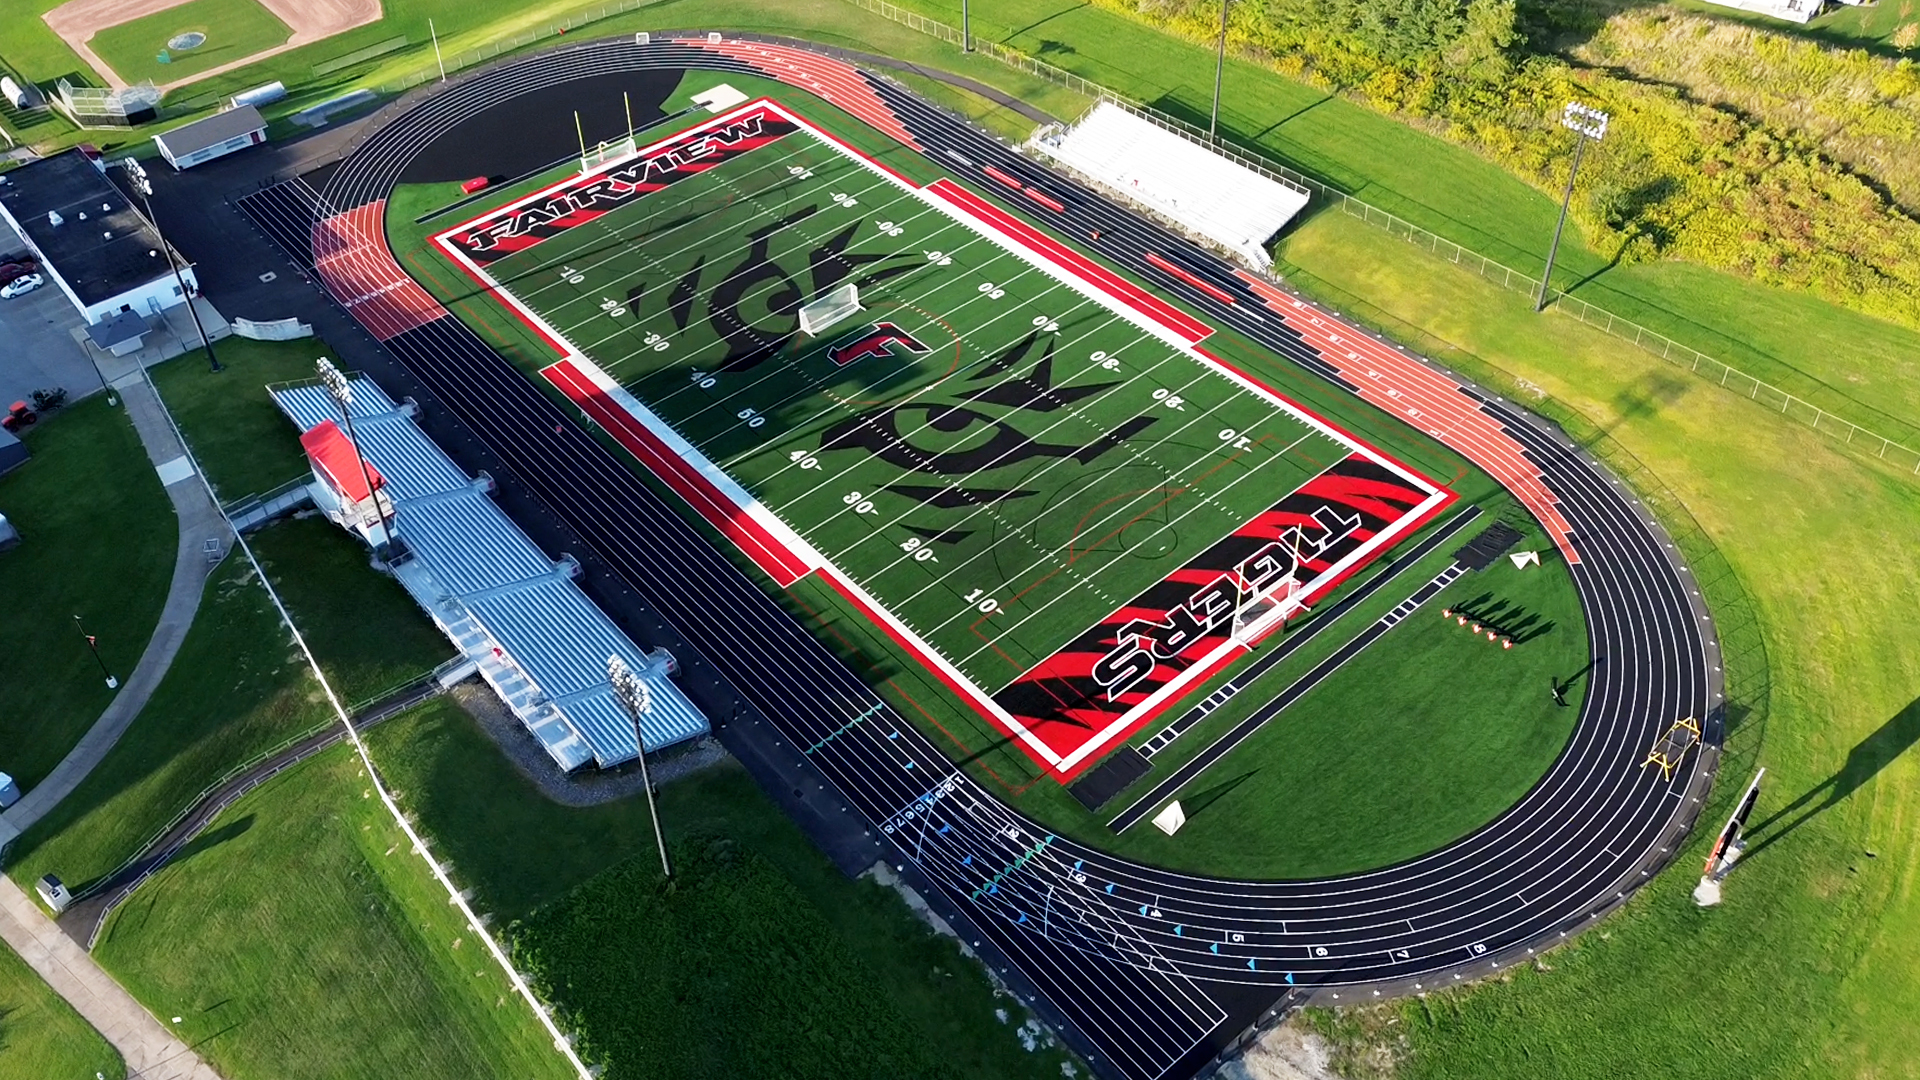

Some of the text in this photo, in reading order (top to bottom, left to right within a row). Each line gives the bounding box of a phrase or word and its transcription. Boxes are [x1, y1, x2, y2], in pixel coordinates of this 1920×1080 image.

[466, 112, 765, 252] FAIRVIEW
[790, 166, 814, 181] 10
[833, 193, 859, 208] 20
[878, 221, 904, 237] 30
[926, 250, 952, 266] 40
[560, 268, 585, 285] 10
[978, 282, 1005, 300] 50
[599, 299, 626, 318] 20
[1032, 315, 1060, 334] 40
[643, 333, 670, 352] 30
[827, 322, 933, 367] F
[1089, 350, 1120, 371] 30
[690, 370, 717, 389] 40
[1152, 388, 1183, 409] 20
[737, 408, 766, 428] 50
[1218, 428, 1251, 450] 10
[789, 449, 819, 471] 40
[843, 491, 874, 514] 30
[899, 537, 934, 562] 20
[963, 588, 998, 613] 10
[1092, 505, 1362, 703] TIGERS
[954, 775, 965, 785] 1
[914, 803, 926, 813] 5
[883, 824, 895, 834] 8
[1007, 828, 1020, 839] 2
[1075, 873, 1087, 883] 3
[1150, 909, 1162, 919] 4
[1232, 933, 1245, 943] 5
[1315, 946, 1328, 957] 6
[1396, 949, 1410, 960] 7
[1473, 943, 1486, 954] 8
